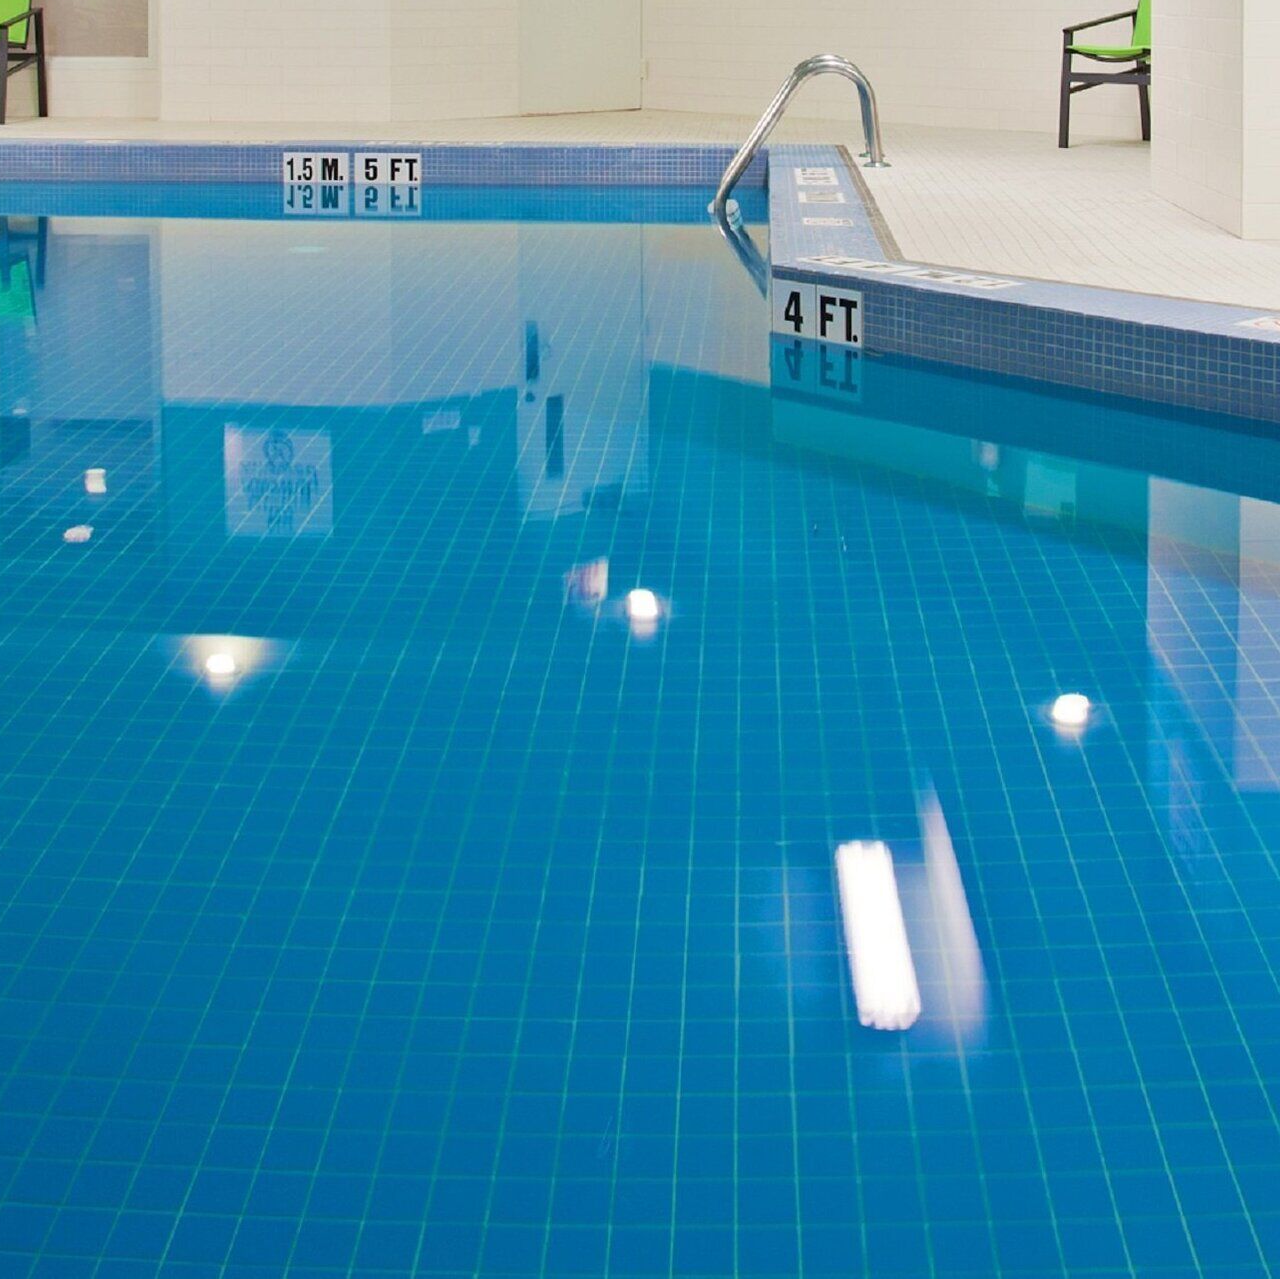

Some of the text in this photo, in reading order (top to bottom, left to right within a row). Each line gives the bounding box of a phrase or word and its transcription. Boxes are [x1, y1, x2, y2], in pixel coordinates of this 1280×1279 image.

[286, 157, 418, 181] 1.5 M. 5 FT.
[784, 291, 858, 343] 4 FT.
